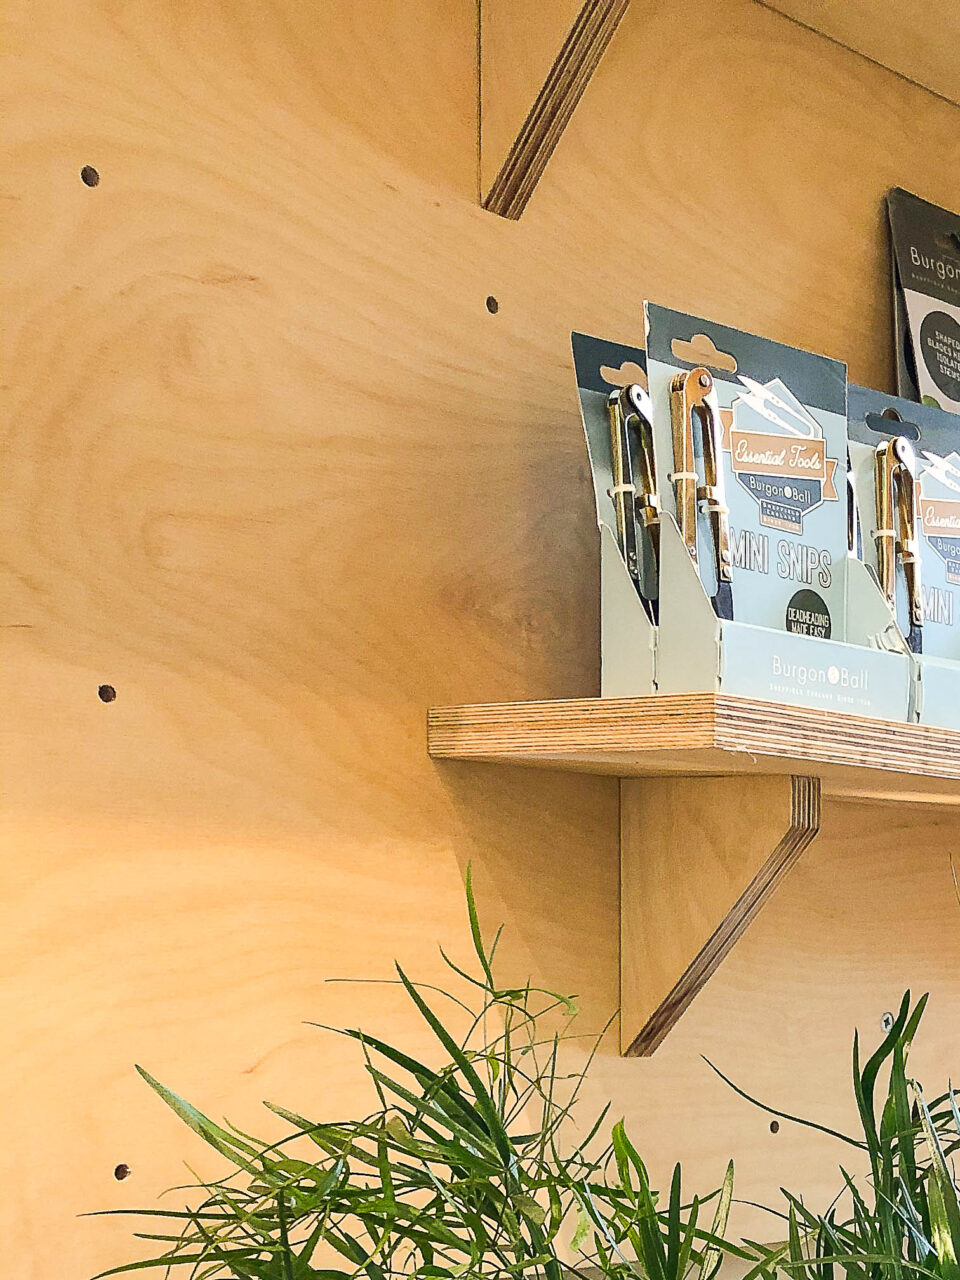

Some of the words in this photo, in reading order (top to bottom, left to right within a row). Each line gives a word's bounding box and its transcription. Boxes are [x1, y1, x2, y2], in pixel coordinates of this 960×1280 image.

[735, 439, 786, 466] Essential
[789, 445, 822, 470] Tools
[749, 475, 785, 497] Burgon
[793, 487, 811, 504] Ball
[729, 527, 769, 575] MINI
[777, 539, 832, 589] SNIPS
[788, 607, 830, 627] DEADHEADING
[921, 585, 953, 627] MINI
[772, 655, 826, 686] Burgon
[840, 667, 868, 691] Ball
